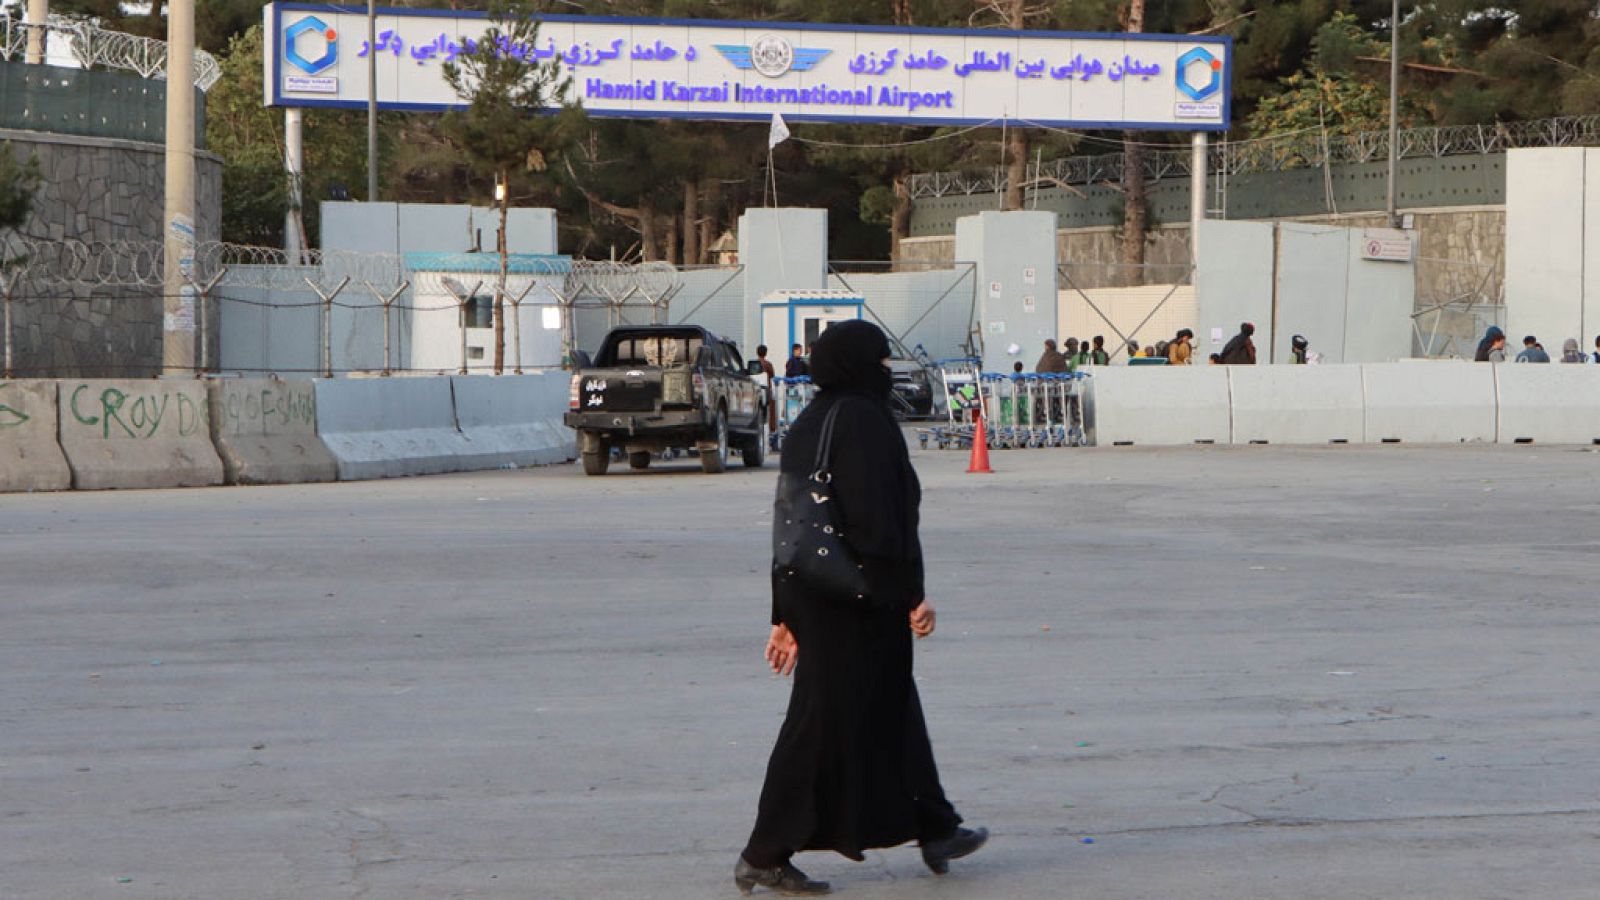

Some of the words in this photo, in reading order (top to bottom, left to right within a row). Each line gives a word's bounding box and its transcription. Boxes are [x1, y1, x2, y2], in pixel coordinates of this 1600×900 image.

[629, 39, 681, 62] حامد
[902, 49, 949, 71] حامد
[1013, 57, 1047, 79] بین
[1106, 53, 1162, 82] میدان
[585, 77, 658, 101] Hamid
[661, 79, 731, 103] Karzai
[734, 82, 874, 107] International
[877, 83, 954, 112] Airport
